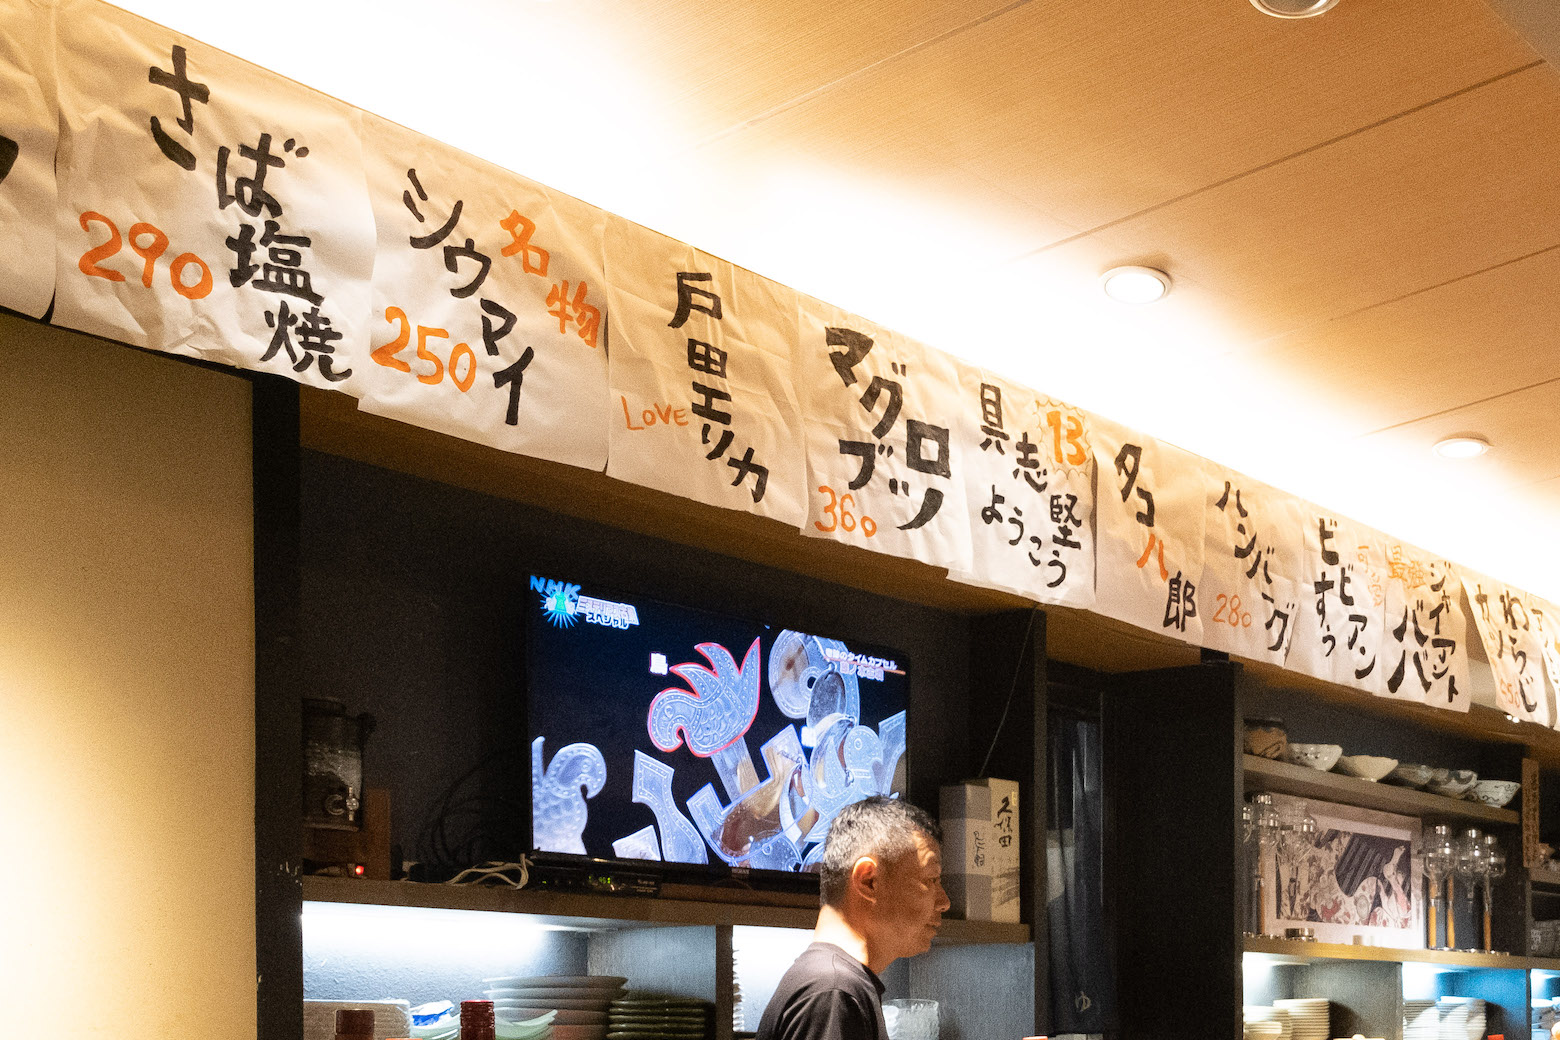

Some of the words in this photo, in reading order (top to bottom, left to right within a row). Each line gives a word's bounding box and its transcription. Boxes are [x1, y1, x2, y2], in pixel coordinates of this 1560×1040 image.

[78, 210, 213, 300] 290
[148, 44, 352, 382] さば塩焼
[402, 168, 535, 426] シウマイ
[499, 209, 601, 348] 名物
[370, 306, 478, 393] 250
[667, 271, 770, 503] 戸田エリカ
[979, 383, 1083, 551] 具志堅
[1046, 410, 1085, 466] 13
[814, 486, 878, 539] 360
[1215, 481, 1296, 652] ハンバーグ
[530, 575, 581, 600] NHK
[1212, 593, 1252, 628] 280
[1319, 517, 1377, 680] ビビアン
[1429, 561, 1459, 703] ジャイアント
[1387, 600, 1433, 694] ババ
[993, 795, 1012, 848] 久保田
